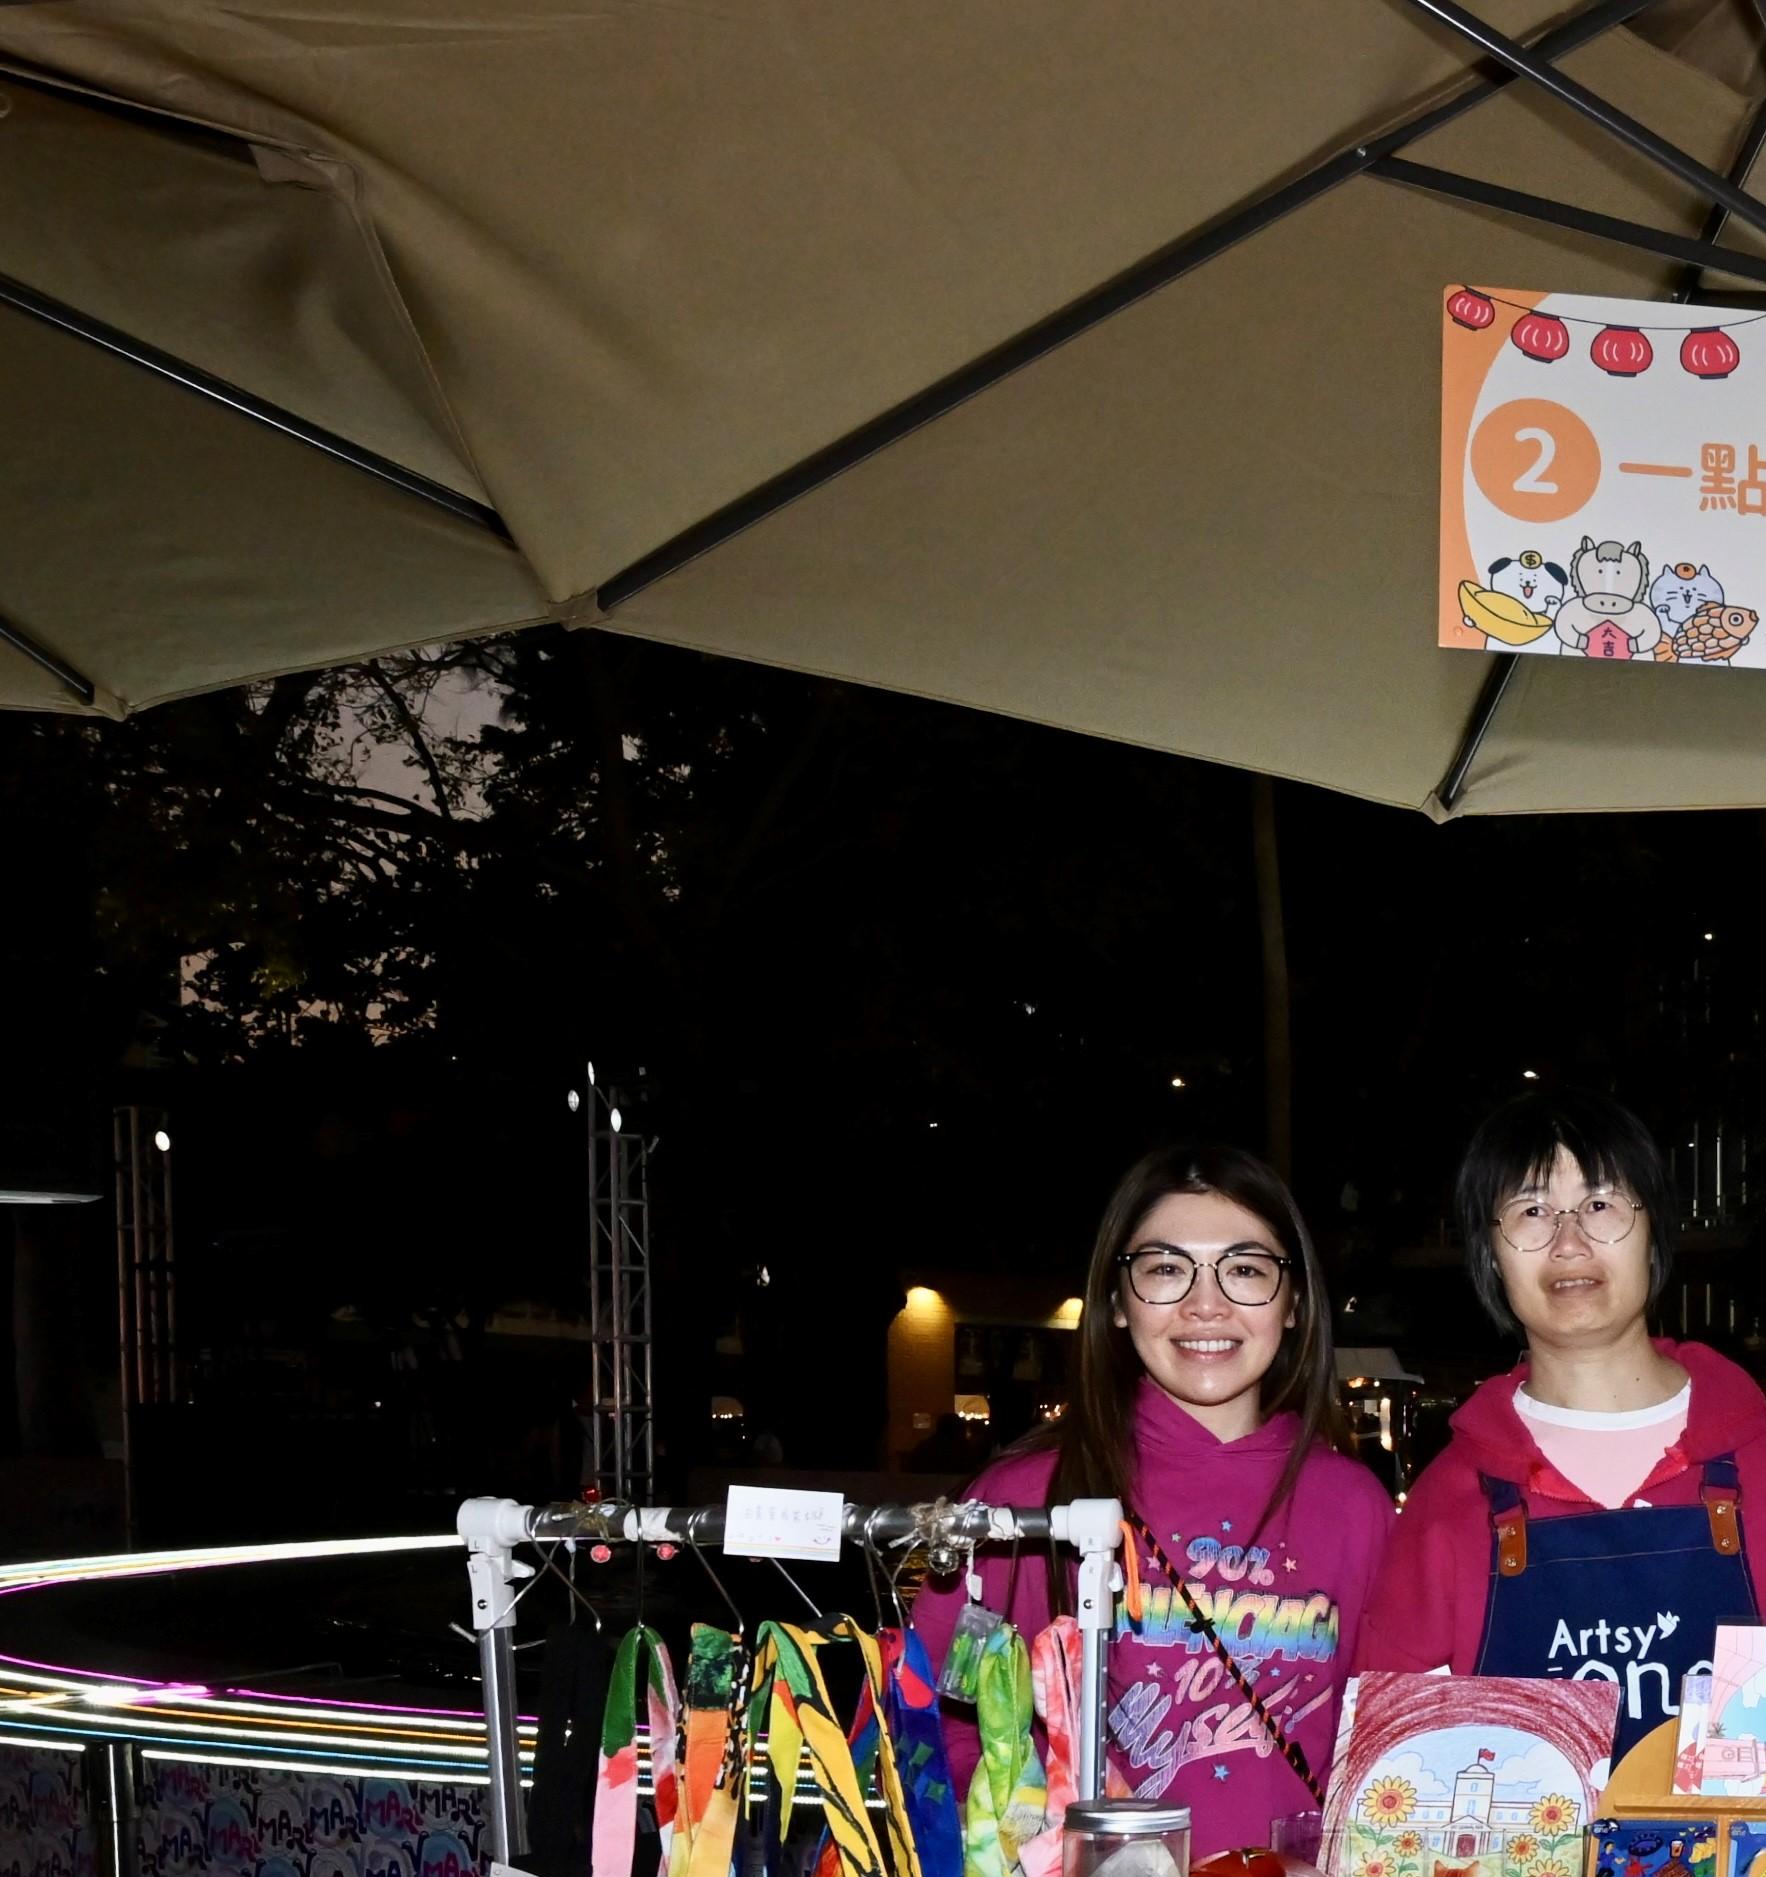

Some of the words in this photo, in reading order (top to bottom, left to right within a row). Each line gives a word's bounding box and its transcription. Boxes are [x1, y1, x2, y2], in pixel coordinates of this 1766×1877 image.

[1512, 427, 1560, 494] 2
[1186, 1537, 1276, 1587] 90%
[1548, 1619, 1657, 1660] Artsy
[1174, 1656, 1262, 1705] 10%
